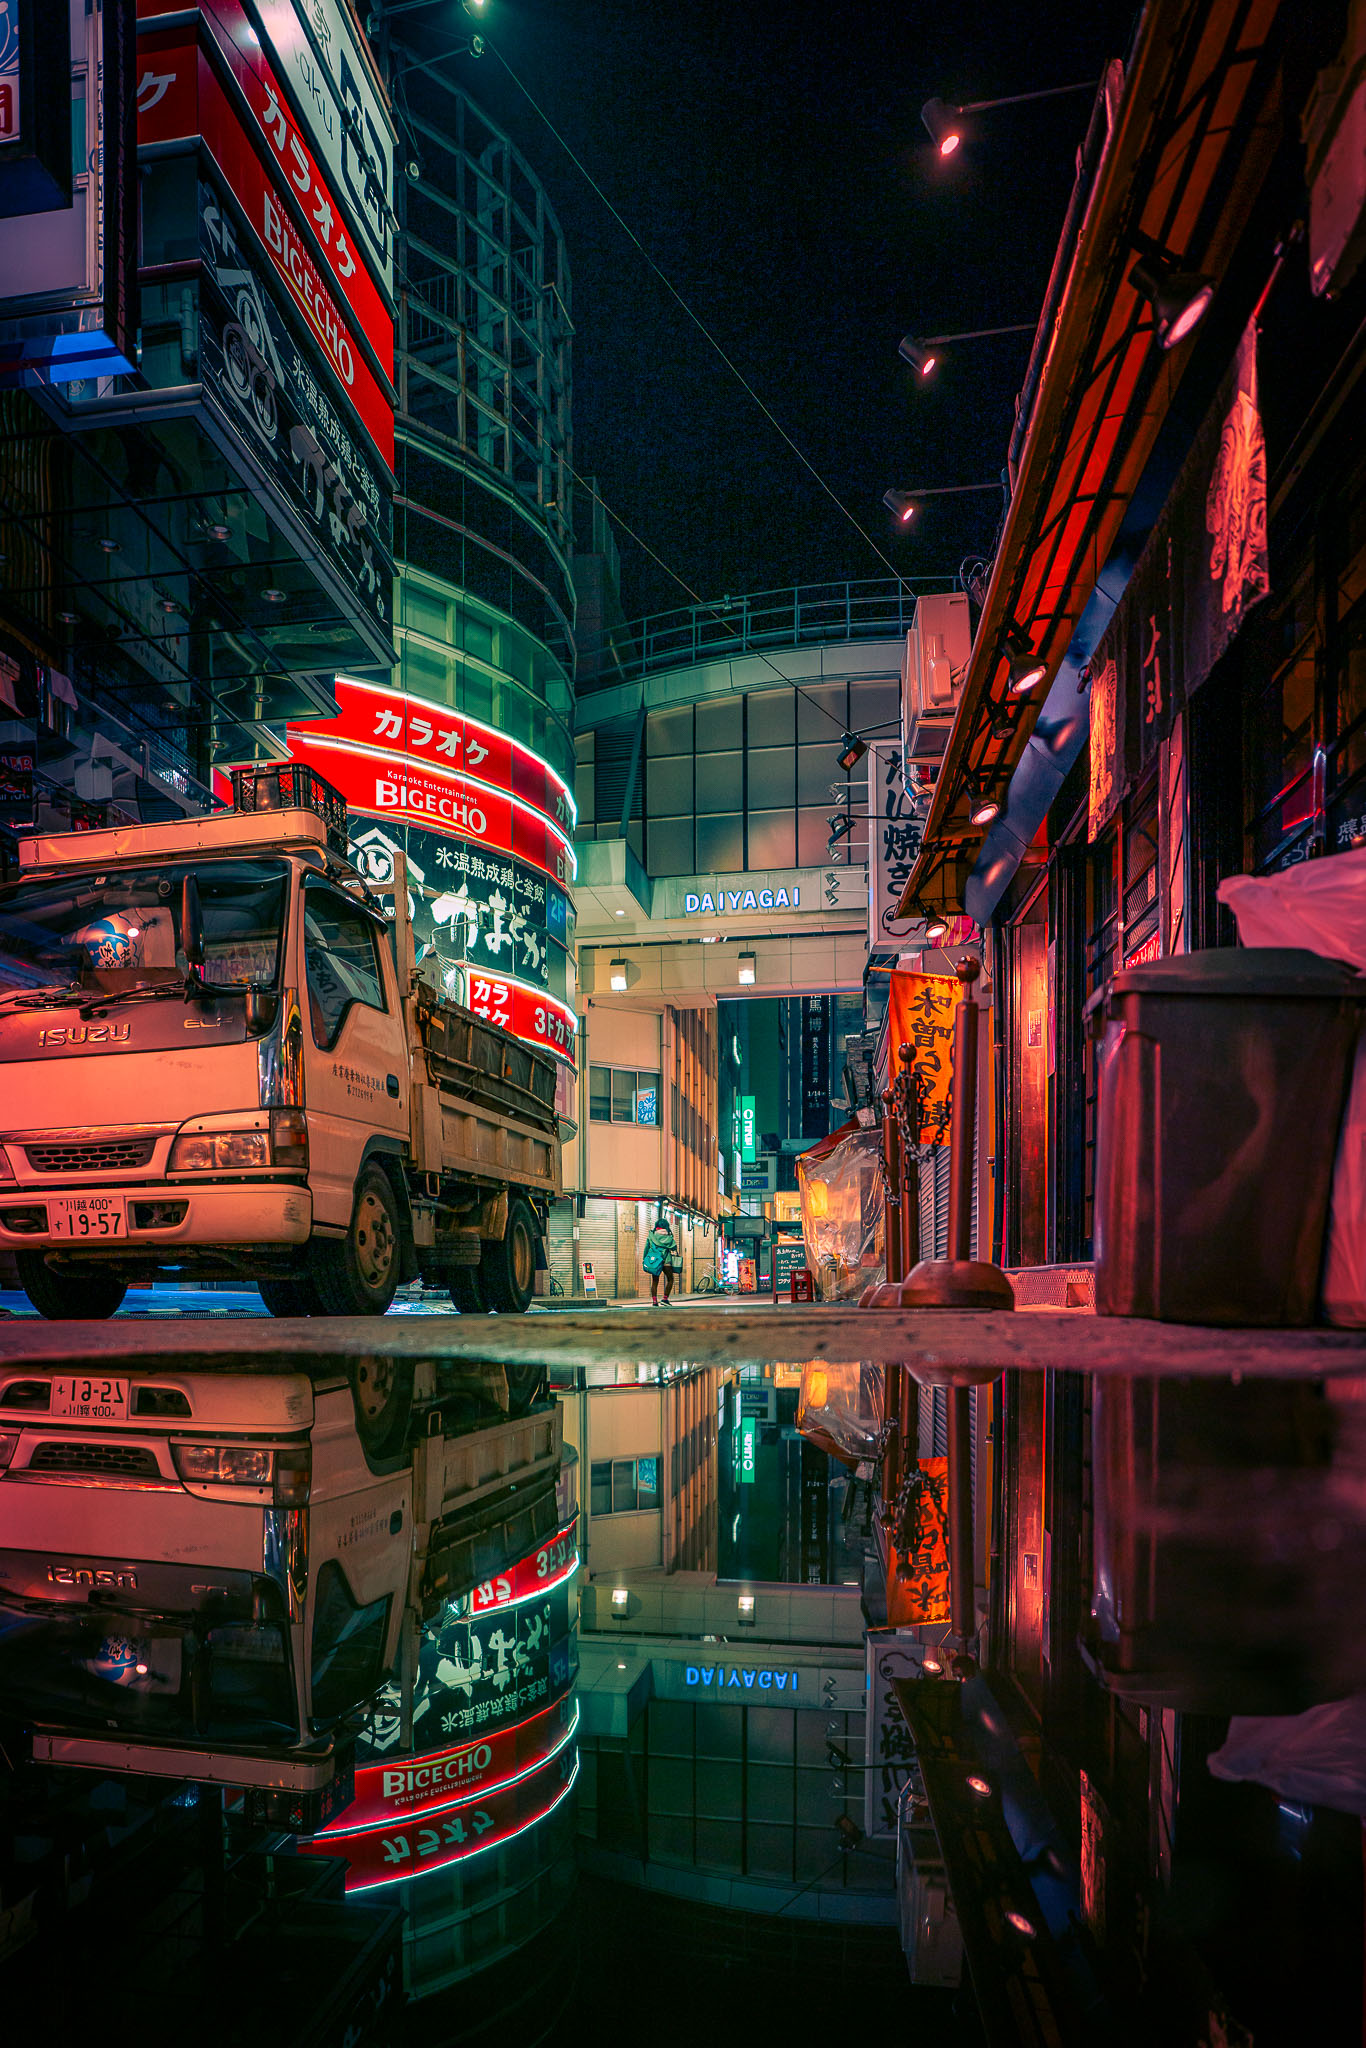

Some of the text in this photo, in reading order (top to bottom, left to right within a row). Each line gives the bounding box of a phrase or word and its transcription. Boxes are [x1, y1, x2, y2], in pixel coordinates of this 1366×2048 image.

[262, 81, 357, 280] カラオケ
[263, 190, 355, 386] BIGECHO
[373, 709, 489, 765] カラオケ
[387, 770, 478, 805] Karaoke Entertainment
[376, 779, 487, 834] BIGECHO
[435, 846, 545, 904] 氷温熟成鶏と釜飯
[550, 893, 565, 924] 2F
[685, 887, 800, 912] DAIYAGAI
[473, 979, 509, 1005] カラ
[38, 1023, 131, 1047] ISUZU
[66, 1198, 109, 1212] 川越 400
[68, 1212, 121, 1236] 19-57
